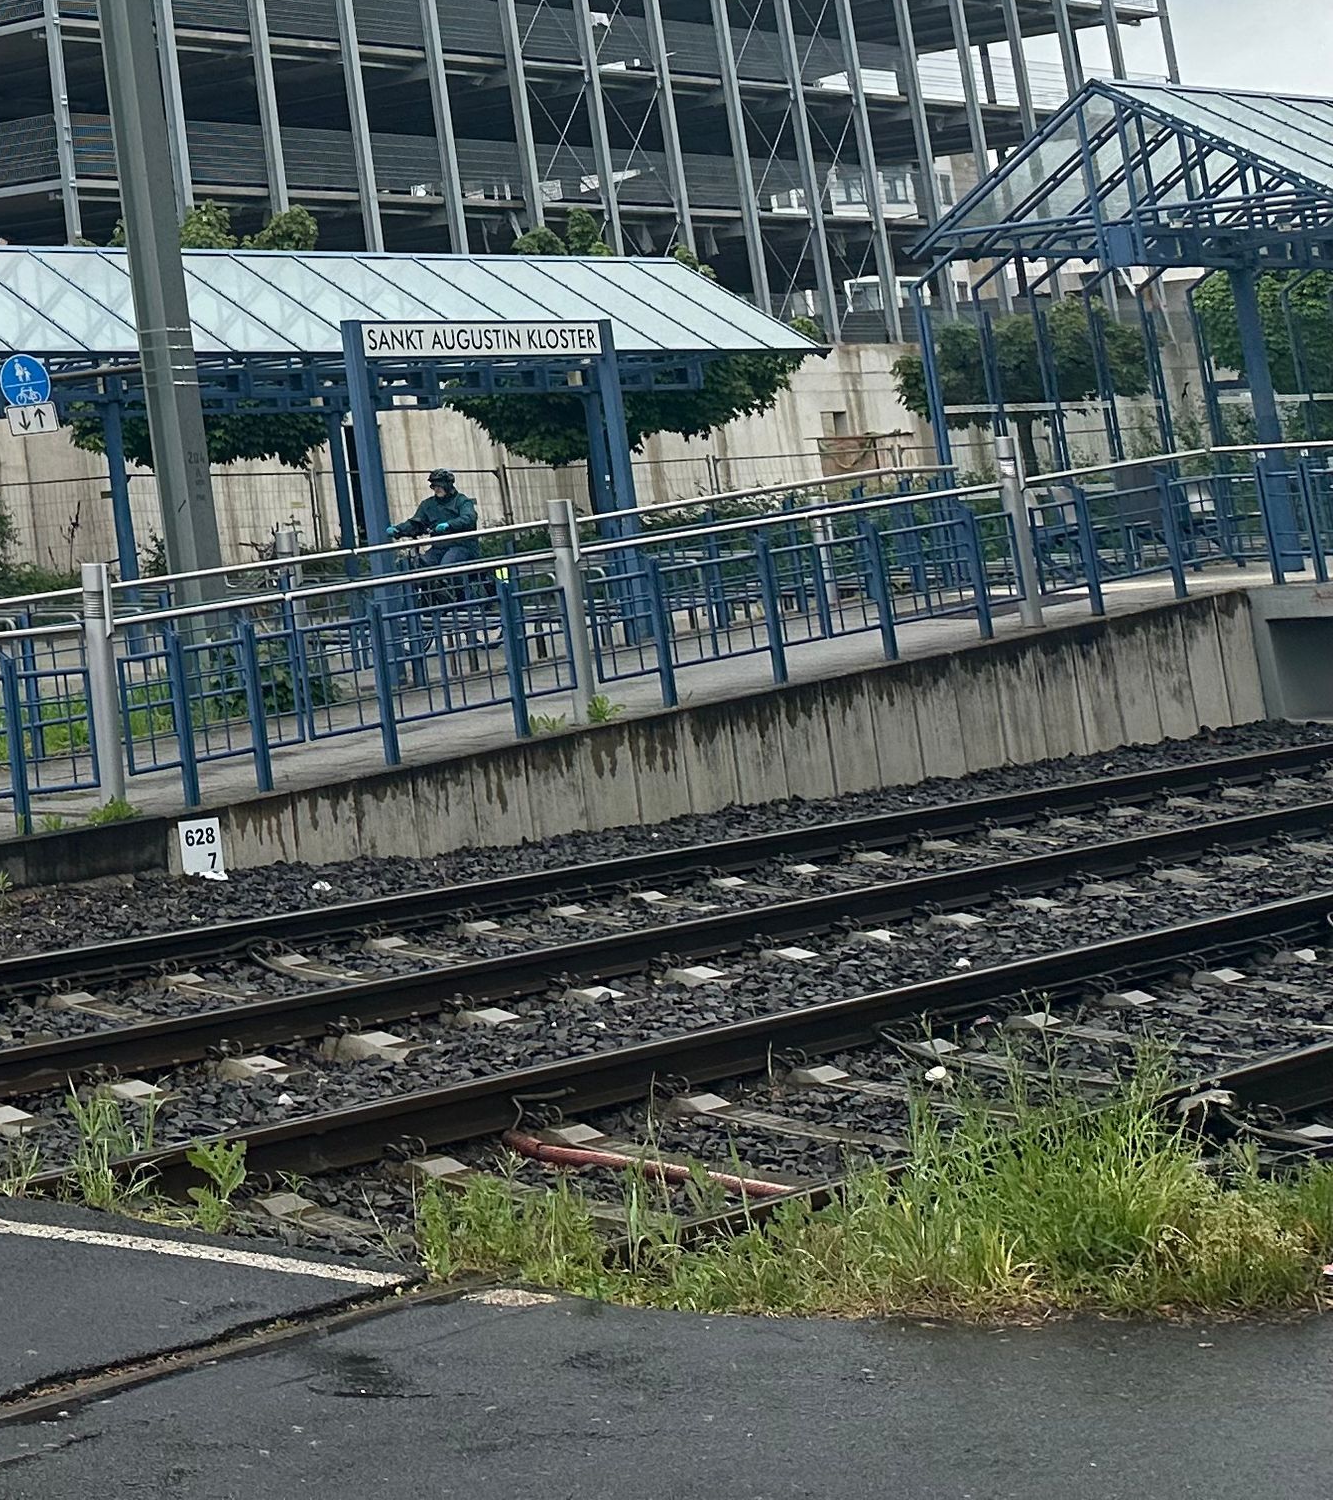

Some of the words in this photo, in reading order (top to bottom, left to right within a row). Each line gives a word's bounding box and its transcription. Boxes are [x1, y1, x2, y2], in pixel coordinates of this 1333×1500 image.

[368, 329, 424, 350] SANKT
[432, 328, 521, 350] AUGUSTIN
[527, 328, 597, 349] KLOSTER
[185, 827, 215, 847] 628
[207, 852, 217, 869] 7
